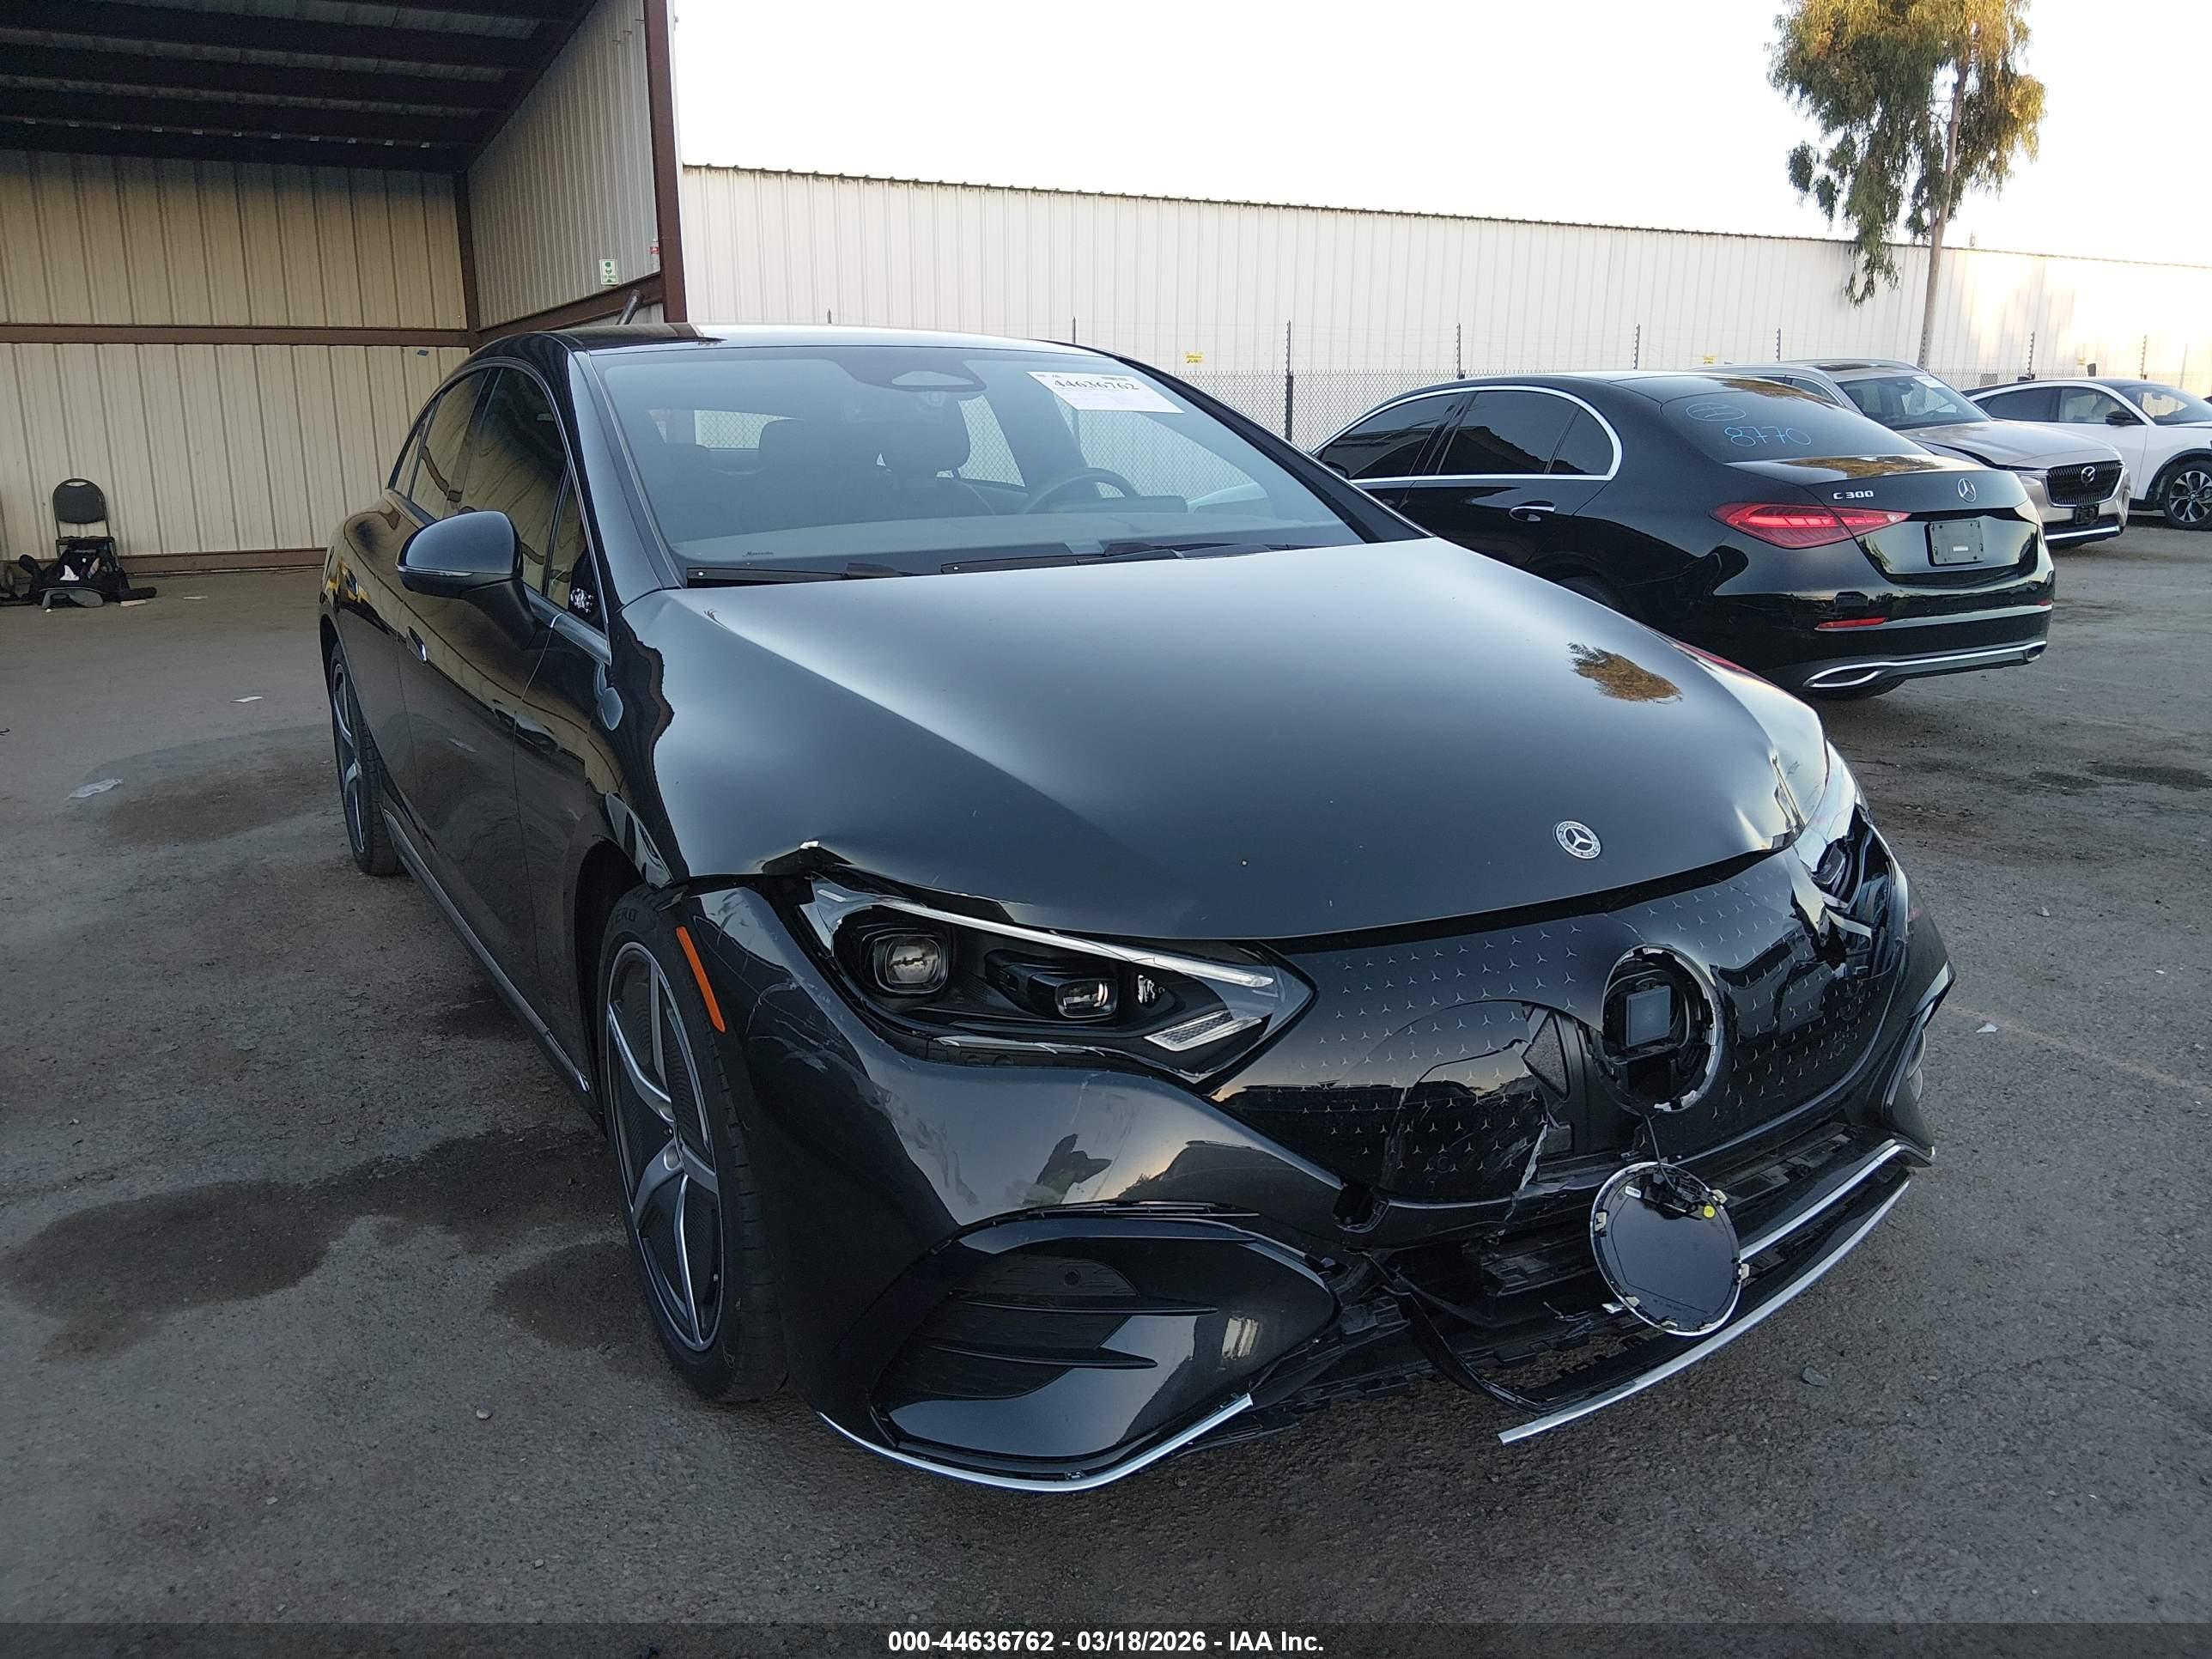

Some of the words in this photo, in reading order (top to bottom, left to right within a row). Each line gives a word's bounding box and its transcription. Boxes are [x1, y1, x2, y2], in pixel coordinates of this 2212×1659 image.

[1054, 380, 1139, 390] 44636762
[1724, 426, 1812, 447] 8770
[1845, 489, 1874, 499] 300
